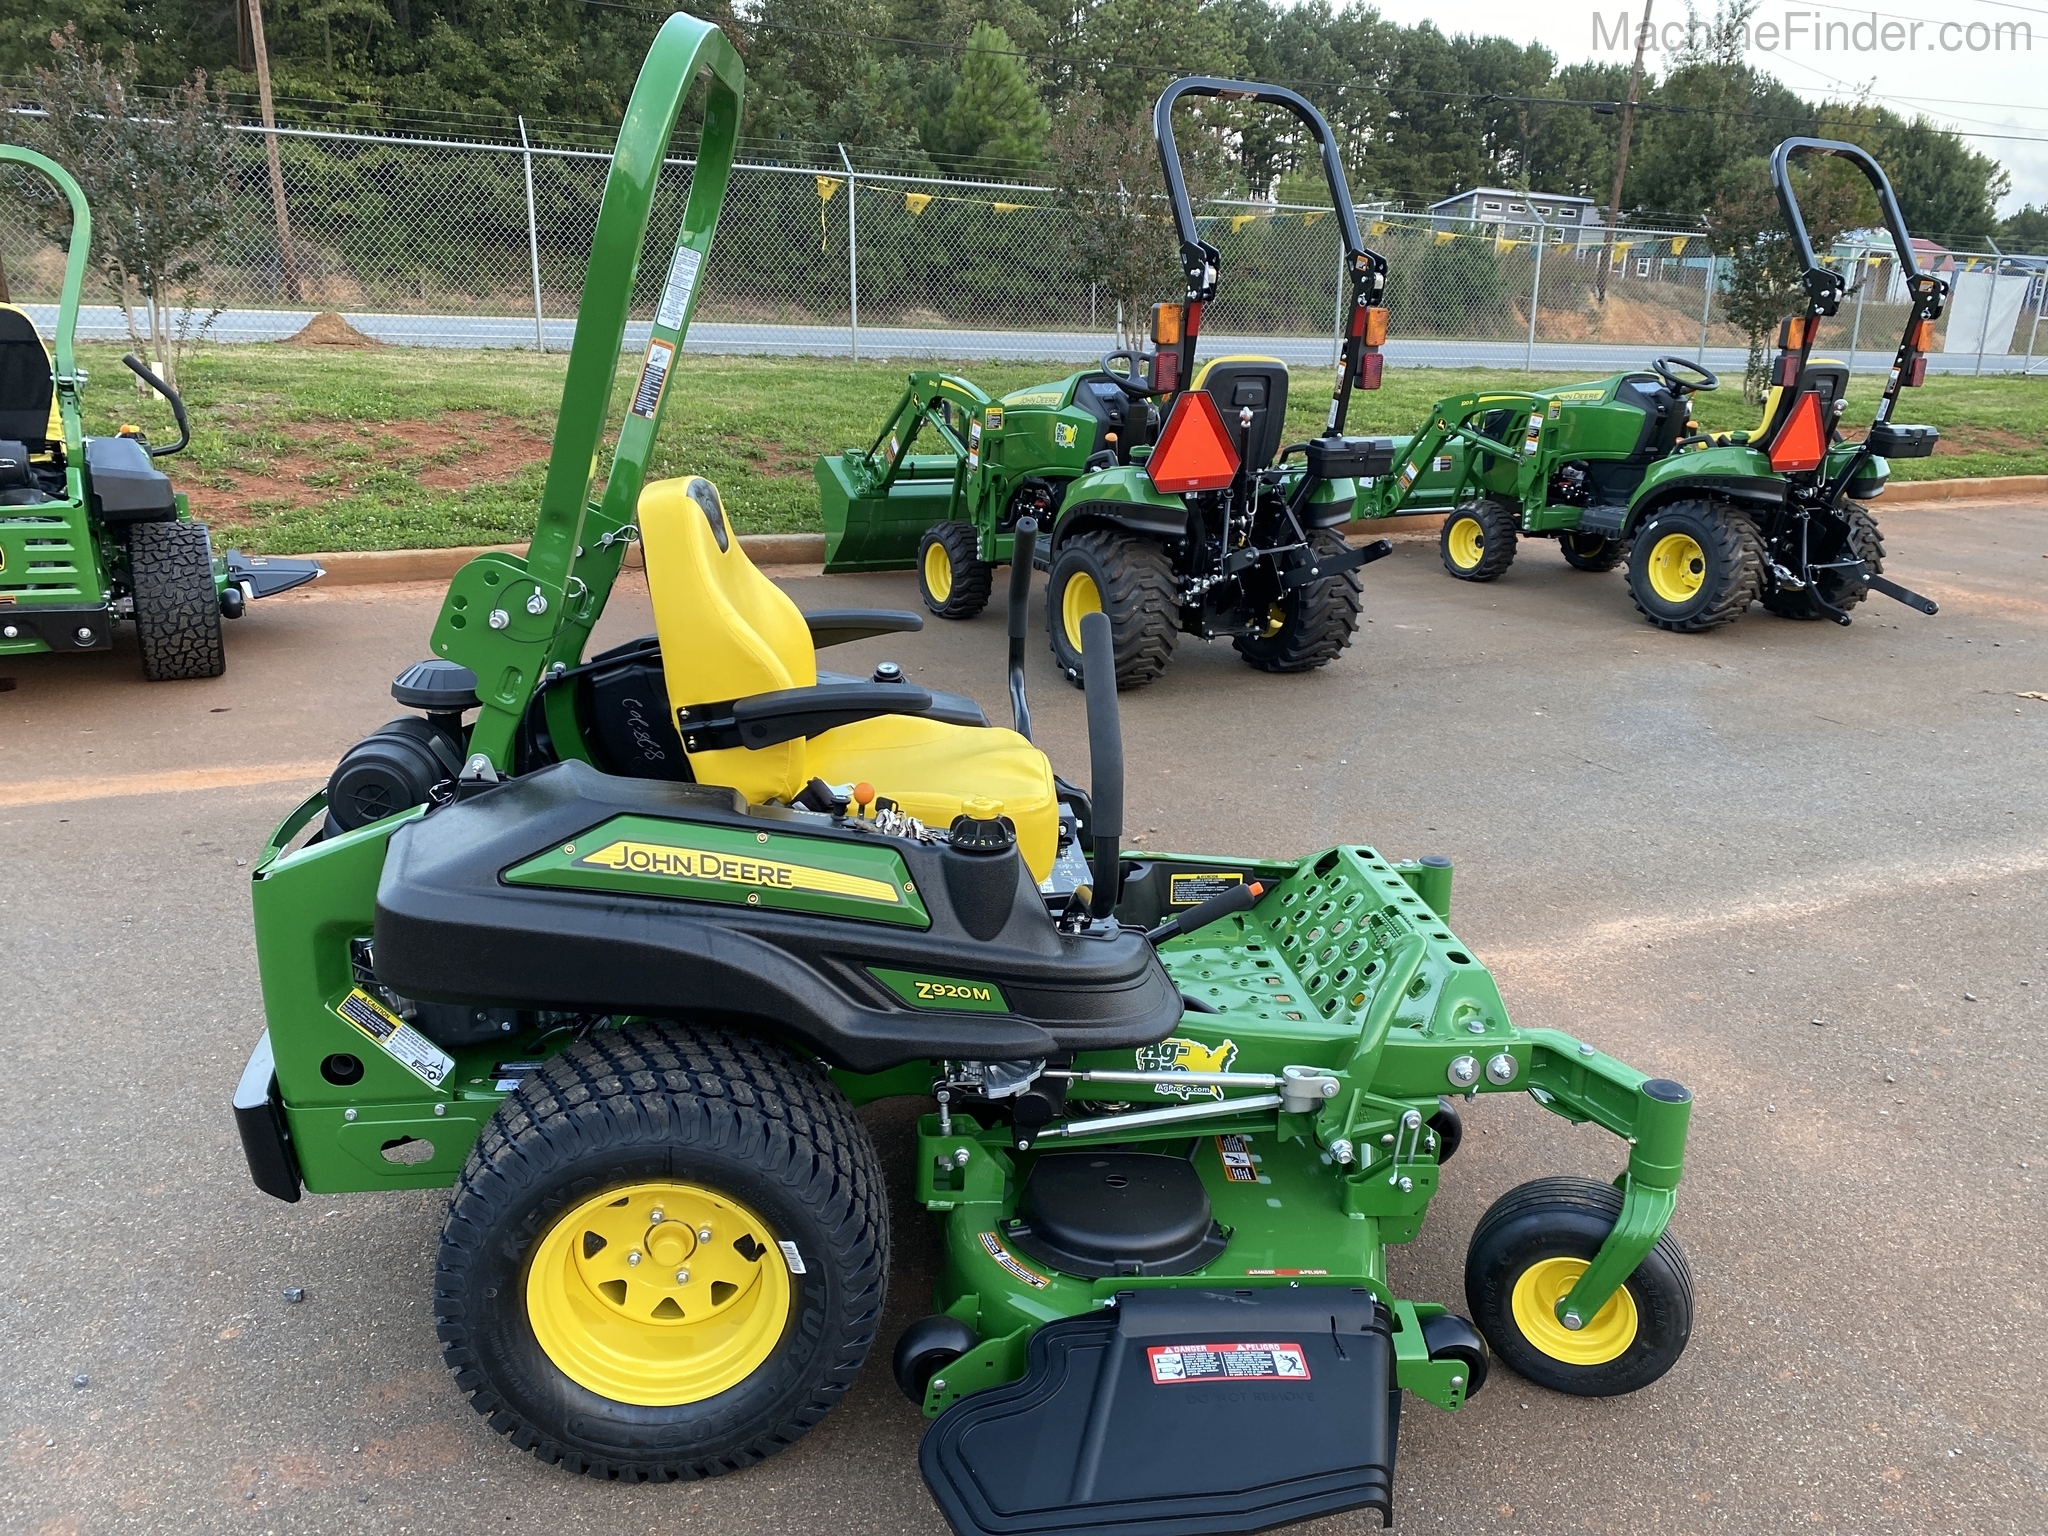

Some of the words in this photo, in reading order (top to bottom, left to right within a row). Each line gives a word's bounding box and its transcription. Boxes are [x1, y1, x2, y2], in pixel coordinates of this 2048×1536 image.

[1020, 396, 1036, 405] JOHN
[1036, 395, 1058, 404] DEERE
[612, 845, 692, 875] JOHN
[699, 853, 793, 887] DEERE
[914, 981, 992, 1001] Z920M
[366, 999, 391, 1020] CAUTION
[1157, 1083, 1211, 1094] AgProCo.com
[501, 1166, 630, 1262] KENDA
[772, 1284, 825, 1391] TURF
[1173, 1345, 1208, 1354] DANGER
[1245, 1343, 1281, 1351] PELIGRO
[1187, 1393, 1210, 1404] DO
[1217, 1392, 1246, 1403] NOT
[1254, 1391, 1316, 1402] REMOVE
